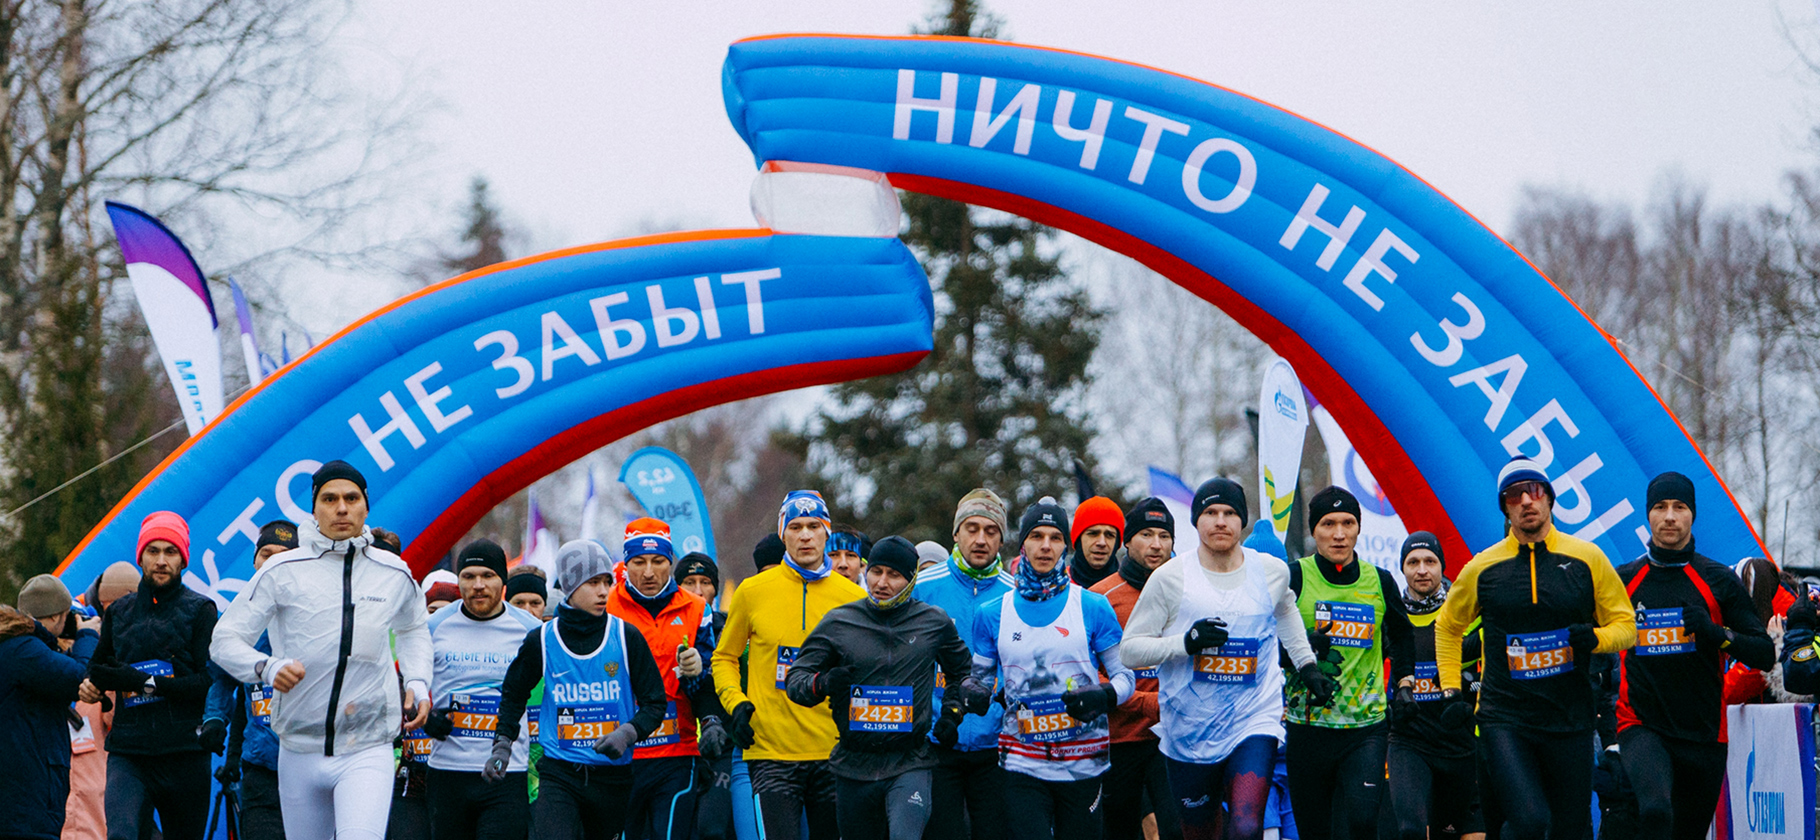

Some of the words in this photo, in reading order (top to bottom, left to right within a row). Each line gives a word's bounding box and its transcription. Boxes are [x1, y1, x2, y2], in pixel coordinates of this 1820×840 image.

[893, 69, 1257, 213] НИЧТО
[1279, 183, 1420, 312] НЕ
[348, 361, 473, 472] НЕ
[473, 268, 782, 399] ЗАБЫТ
[1637, 613, 1645, 621] A
[1646, 628, 1680, 645] 651
[1647, 645, 1670, 653] 42,195
[1203, 657, 1249, 674] 2235
[1519, 649, 1564, 669] 1435
[1207, 674, 1232, 682] 42,195
[1524, 669, 1549, 678] 42,195
[1550, 666, 1561, 674] KM
[552, 680, 621, 703] RUSSIA
[854, 688, 861, 696] A
[562, 707, 570, 715] A
[858, 706, 903, 722] 2423
[462, 714, 496, 729] 477
[1028, 713, 1071, 733] 1855
[460, 729, 483, 737] 42,195
[572, 723, 604, 739] 231
[1033, 732, 1057, 741] 42,195
[1057, 730, 1068, 738] KM
